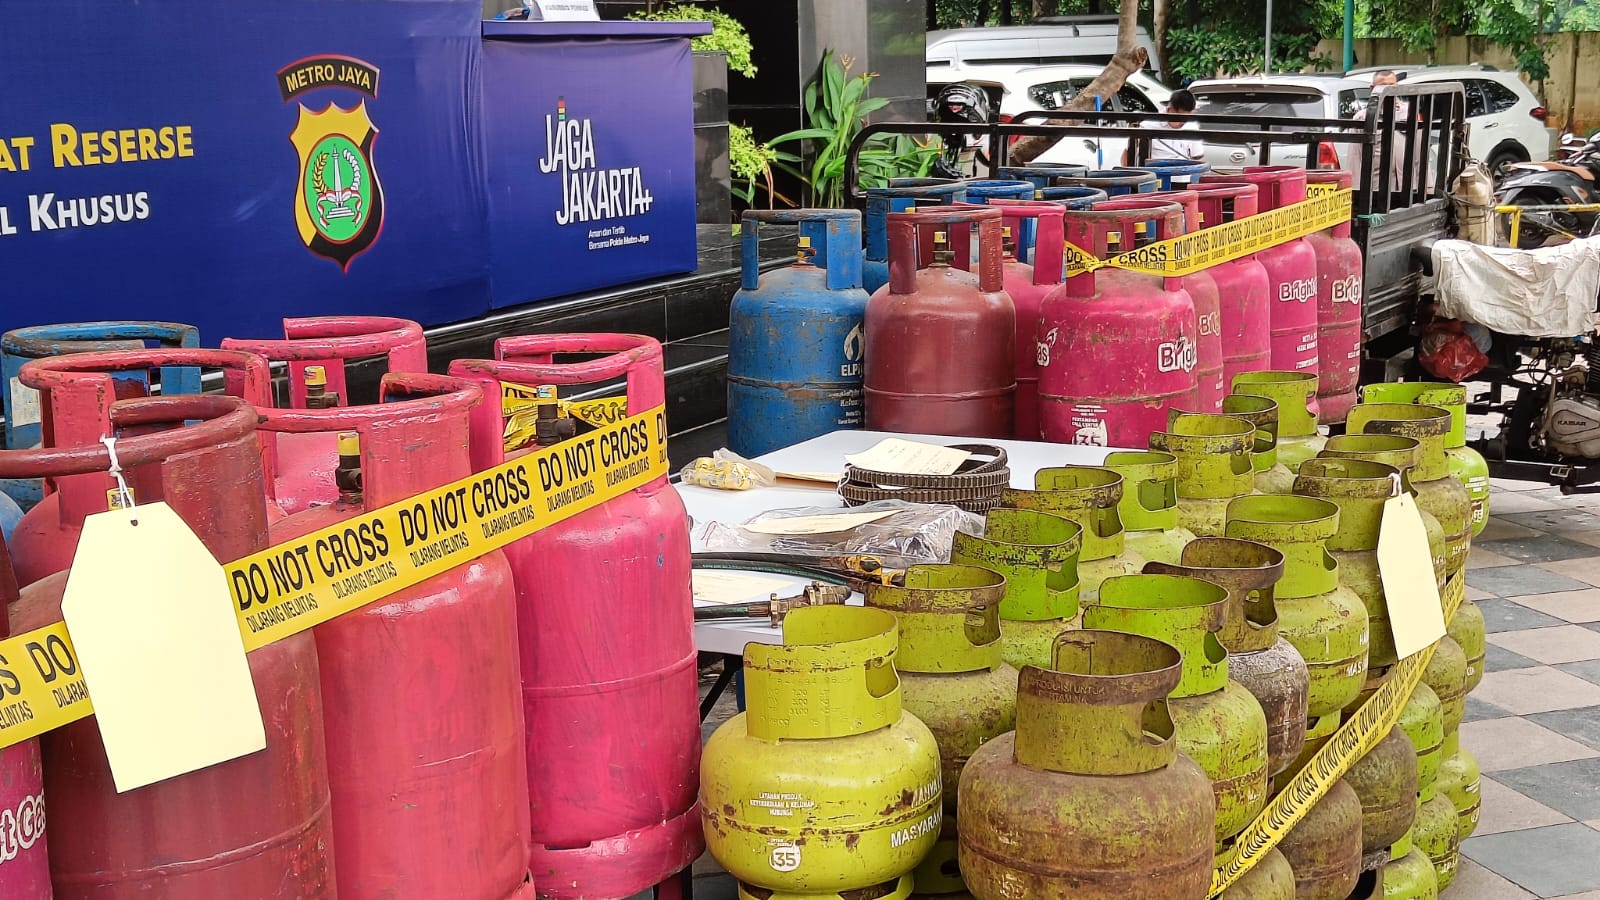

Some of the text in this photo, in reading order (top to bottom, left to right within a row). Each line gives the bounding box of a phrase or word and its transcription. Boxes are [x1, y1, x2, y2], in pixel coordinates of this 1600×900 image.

[285, 64, 371, 93] METRO JAYA
[51, 123, 194, 168] RESERSE
[539, 114, 596, 173] JAGA
[0, 191, 149, 236] L KHUSUS
[1119, 245, 1167, 265] CROSS
[1174, 240, 1183, 260] DO
[1279, 277, 1317, 303] Brigh
[1332, 275, 1361, 305] Brig
[231, 563, 269, 611] DO
[267, 545, 315, 596] NOT
[316, 518, 389, 578] CROSS
[398, 503, 428, 547] DO
[430, 487, 468, 535] NOT
[472, 464, 530, 518] CROSS
[538, 452, 563, 492] DO
[565, 438, 596, 482] NOT
[600, 419, 648, 468] CROSS
[246, 456, 650, 633] DILARANG MELINTAS DILARANG MELINTAS DILARANG MELINTAS DILARANG MELINTAS DILARANG MELINTAS DILARANG MELINTAS
[25, 634, 76, 683] DO
[1337, 718, 1359, 758] CROSS
[770, 852, 797, 867] 135
